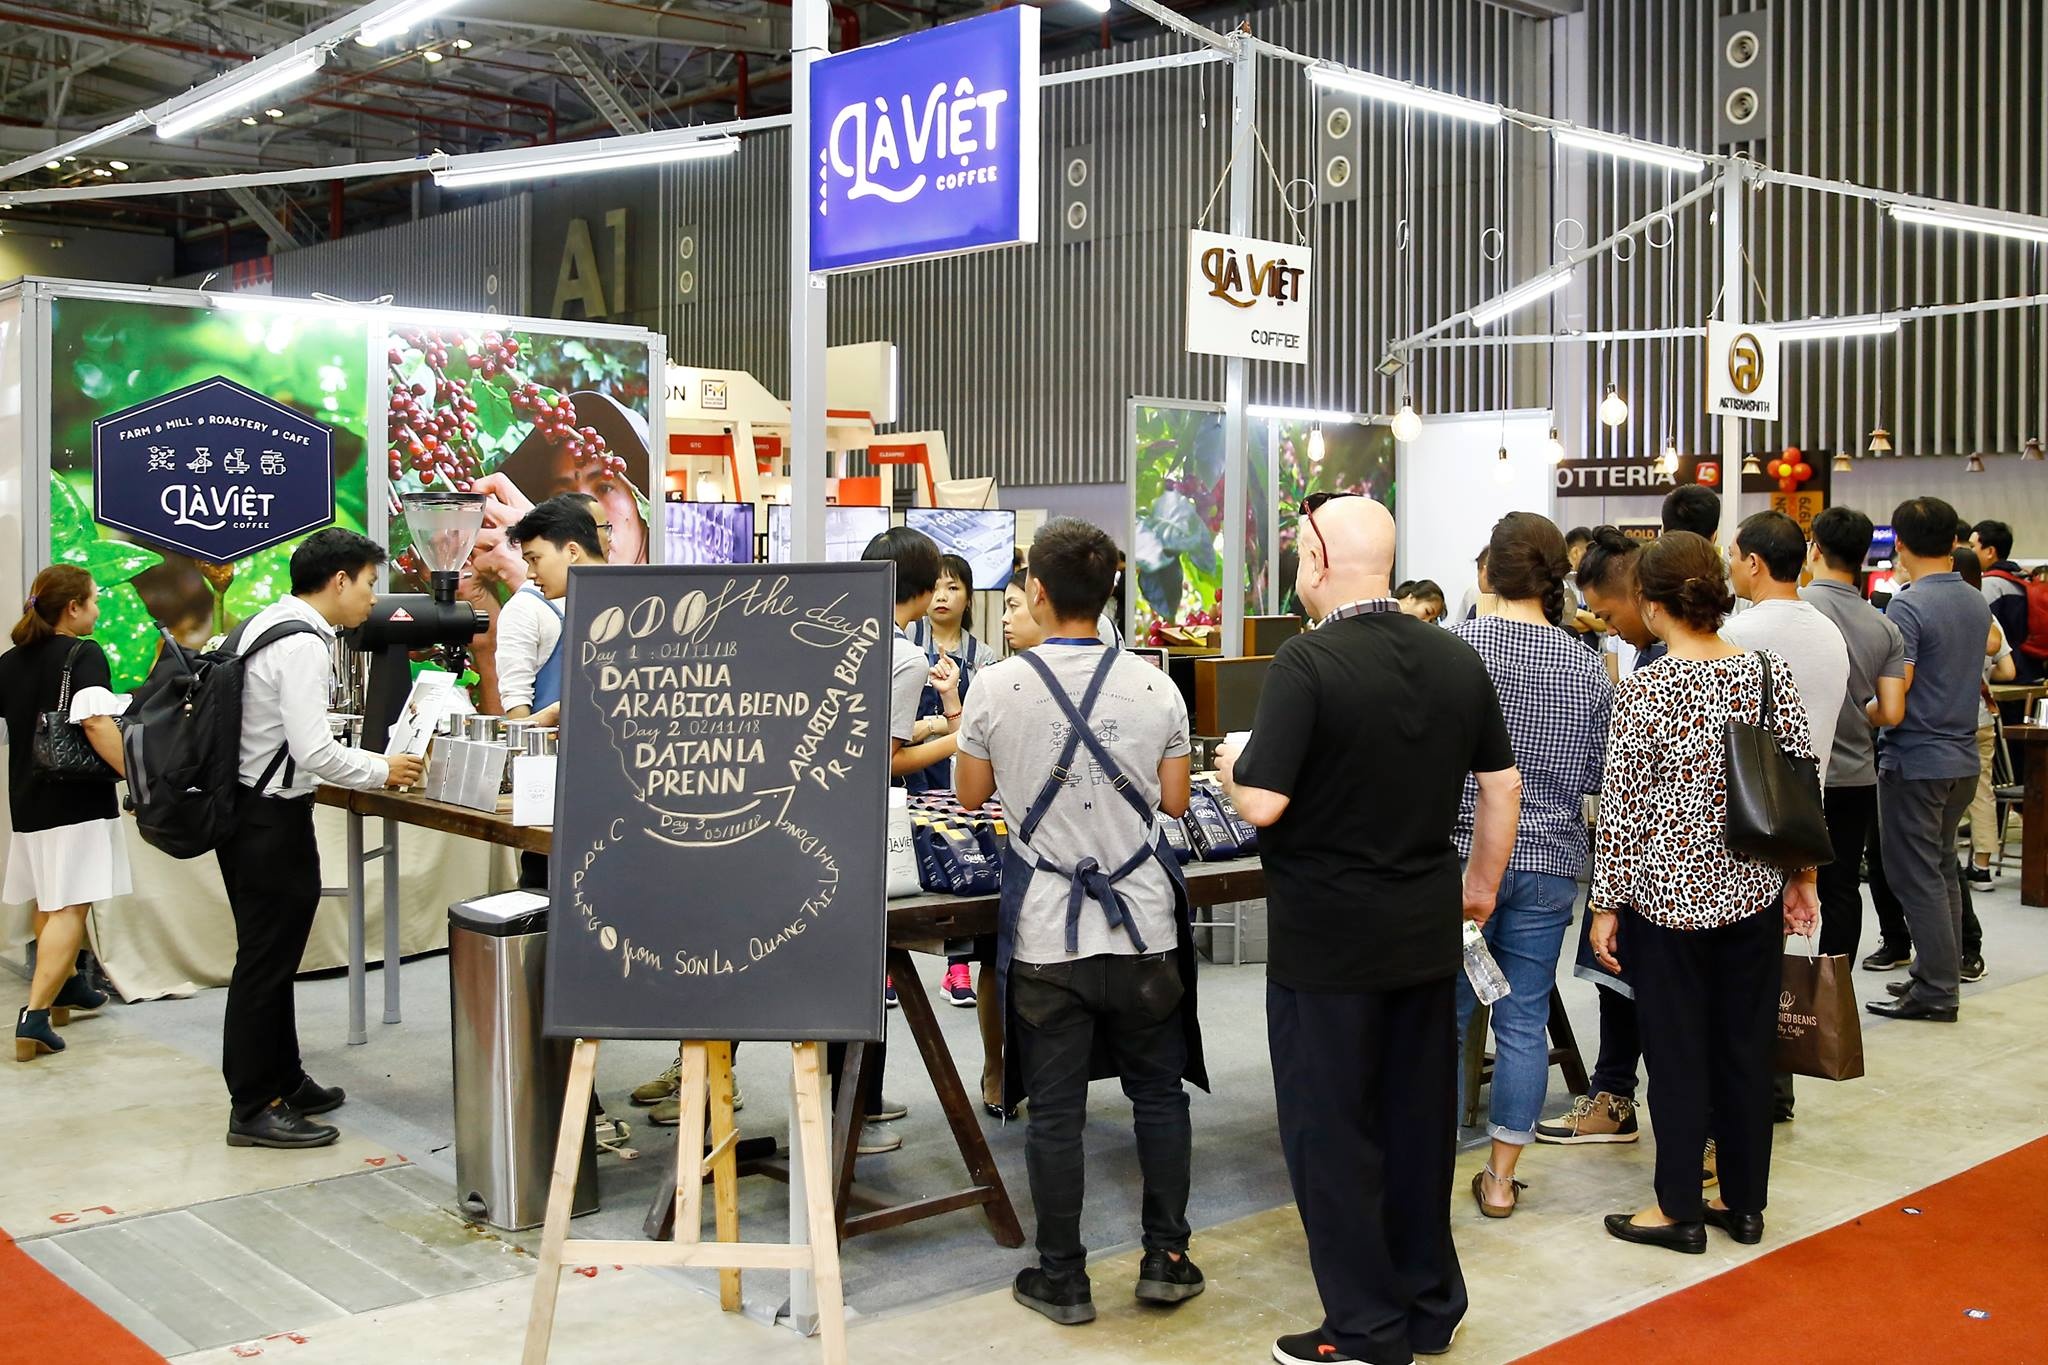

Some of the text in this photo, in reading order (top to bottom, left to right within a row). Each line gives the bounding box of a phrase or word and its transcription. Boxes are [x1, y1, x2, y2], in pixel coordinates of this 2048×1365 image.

[936, 165, 998, 191] COFFEE
[550, 208, 627, 318] A1
[1251, 330, 1300, 348] COFFEE
[120, 415, 310, 446] FARM MILL ROASTERY CAFE
[742, 575, 799, 616] the
[790, 592, 863, 648] day
[583, 641, 737, 666] Day 1 01/11/18
[789, 617, 881, 781] ARABICA BLEND
[1013, 683, 1021, 691] C
[611, 692, 810, 718] ARABICA BLEND
[623, 719, 760, 745] Day 2 02/11/18
[809, 692, 870, 791] PRENN
[648, 767, 746, 796] PRENN
[1084, 802, 1092, 810] H
[661, 814, 689, 834] Day
[695, 818, 706, 831] 3
[623, 938, 663, 978] from
[675, 950, 708, 975] SON
[715, 950, 734, 974] LA
[814, 845, 839, 883] LAM
[1793, 1014, 1817, 1026] BEANS
